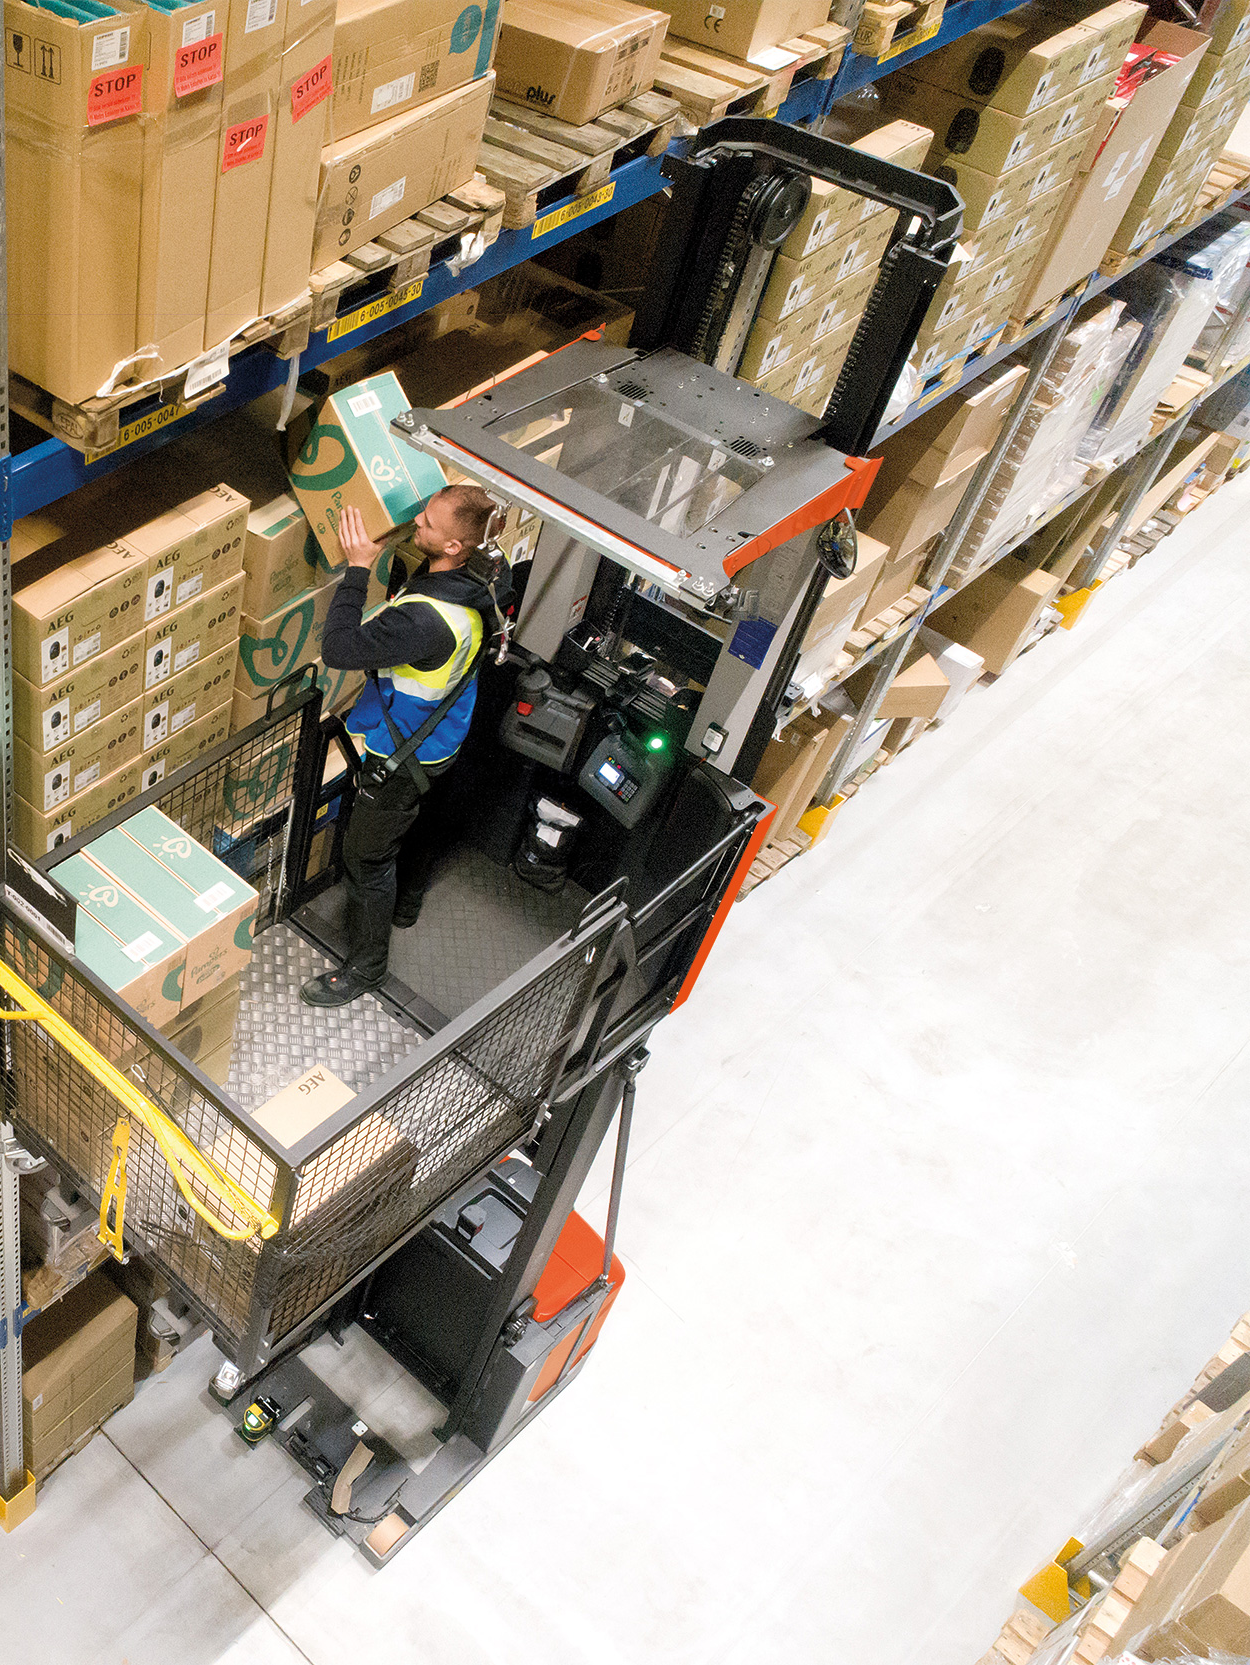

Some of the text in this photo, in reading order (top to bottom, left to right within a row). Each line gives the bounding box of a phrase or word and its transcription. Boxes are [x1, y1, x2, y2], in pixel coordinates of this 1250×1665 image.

[180, 42, 217, 67] STOP
[94, 74, 137, 98] STOP
[296, 65, 328, 99] STOP
[229, 123, 264, 146] STOP
[208, 486, 238, 502] AEG
[105, 541, 135, 559] AEG
[155, 549, 181, 571] AEG
[47, 610, 74, 634] AEG
[154, 621, 178, 642] AEG
[49, 682, 75, 704] AEG
[151, 686, 175, 706] AEG
[50, 746, 75, 768] AEG
[149, 747, 171, 764] AEG
[52, 807, 77, 827] AEG
[298, 1070, 326, 1095] AEG
